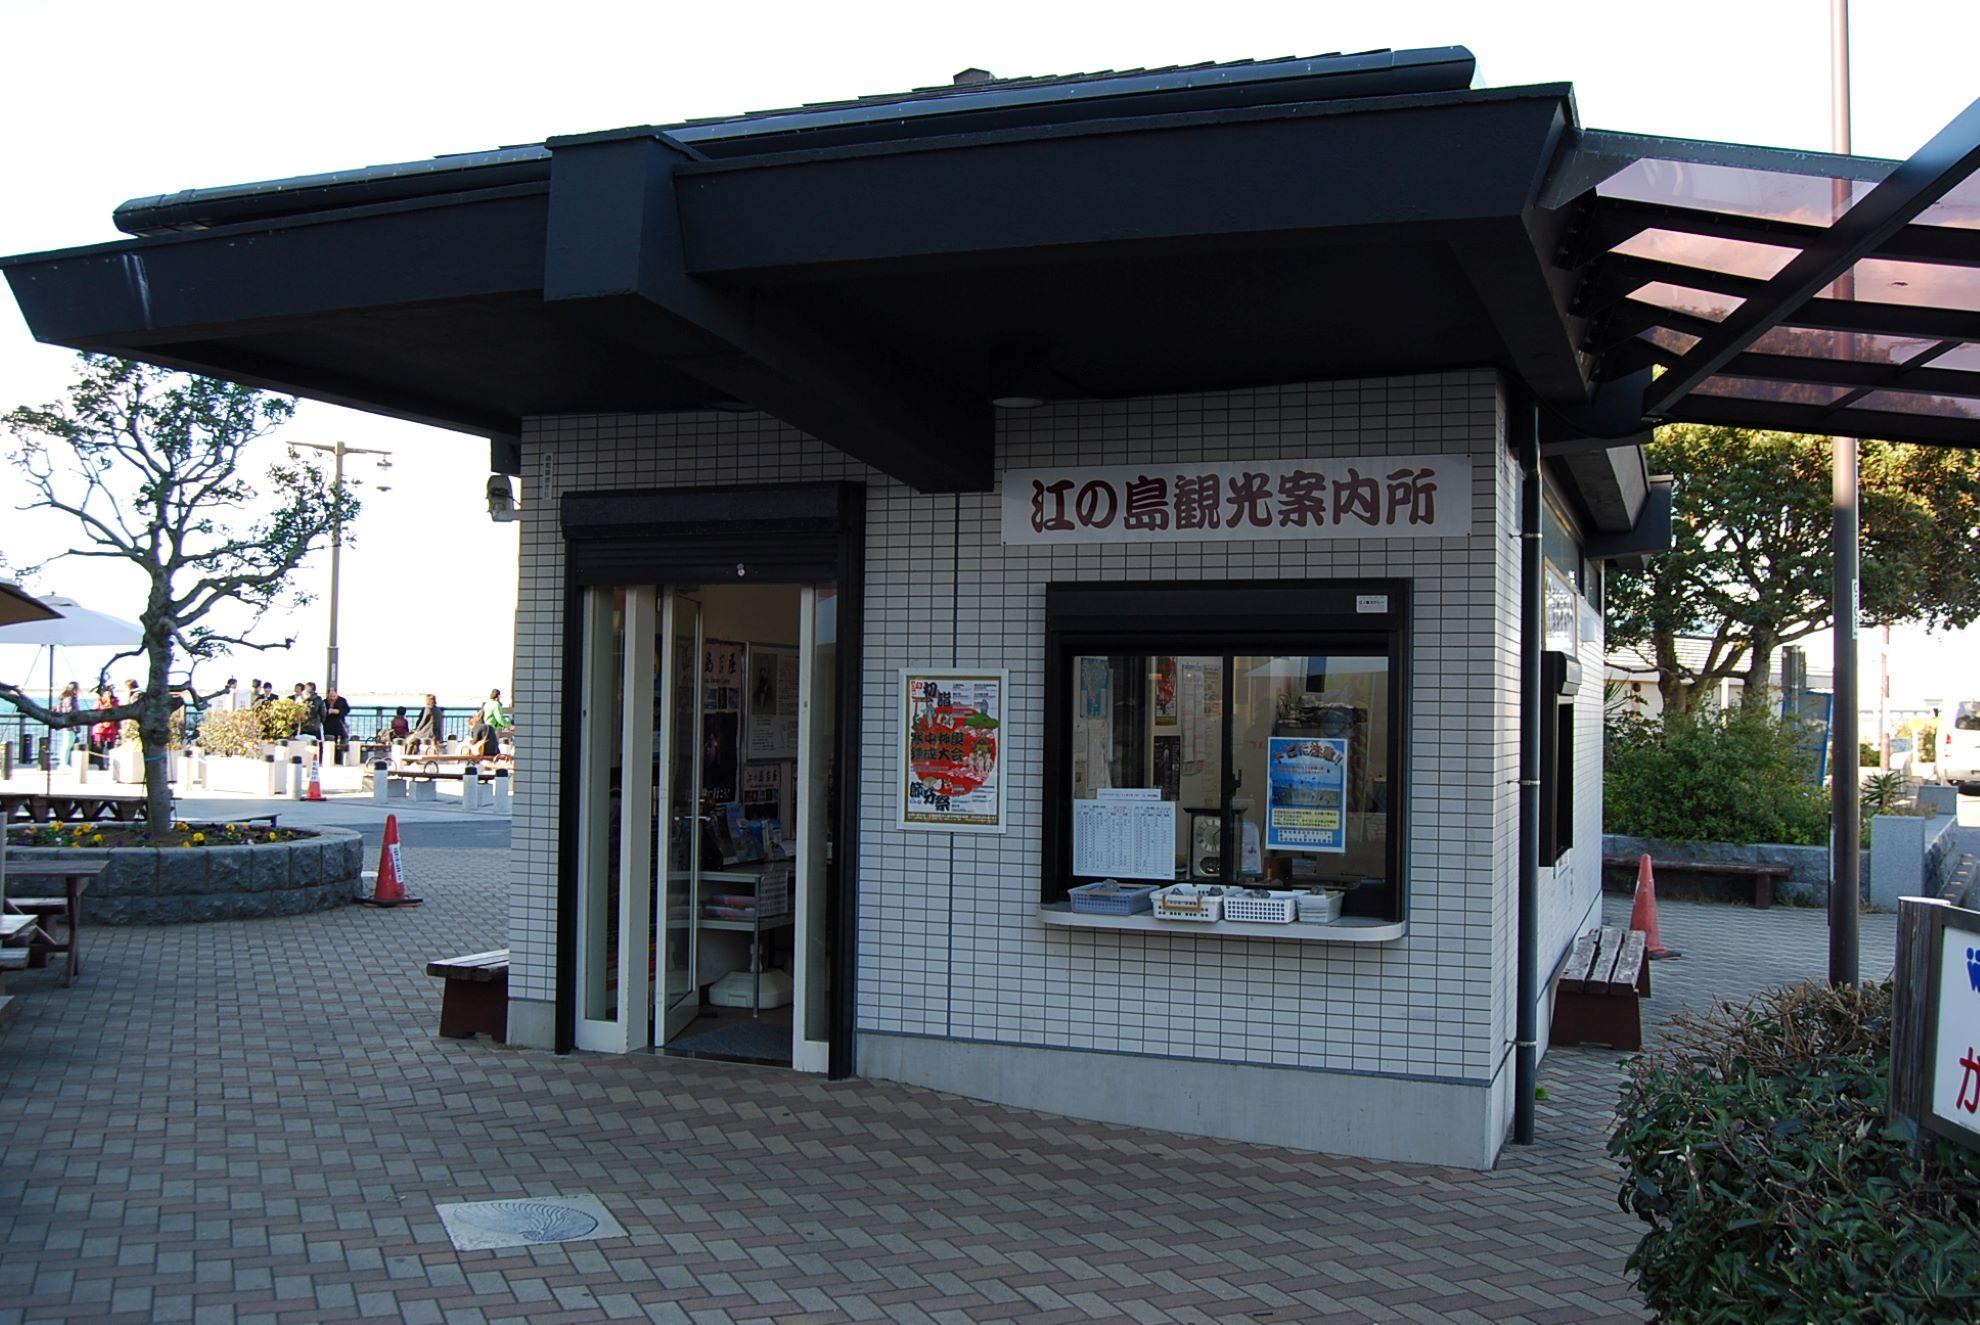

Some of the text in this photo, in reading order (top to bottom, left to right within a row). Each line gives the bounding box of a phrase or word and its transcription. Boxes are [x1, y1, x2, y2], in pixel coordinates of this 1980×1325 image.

[1031, 468, 1437, 533] 江の島観光案内所
